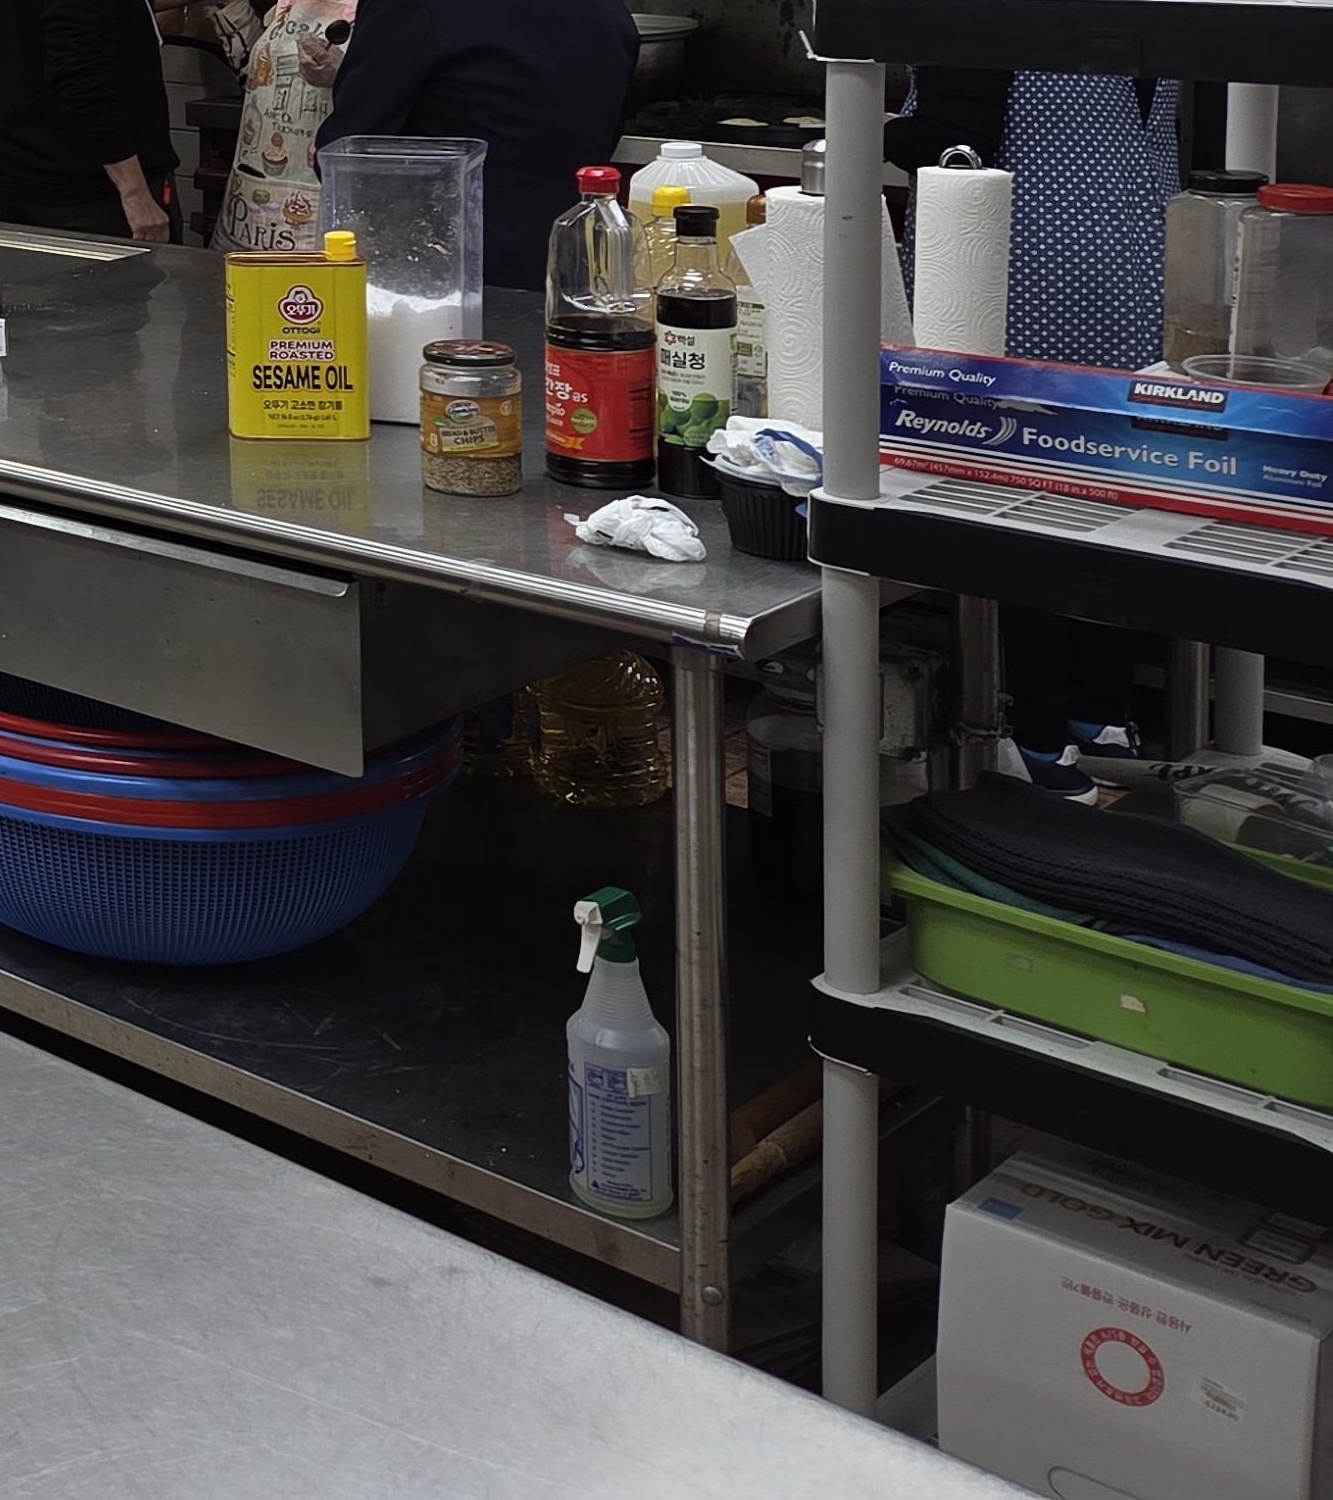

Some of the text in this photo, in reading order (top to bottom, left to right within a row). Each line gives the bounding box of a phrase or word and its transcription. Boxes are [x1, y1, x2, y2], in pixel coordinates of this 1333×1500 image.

[270, 351, 334, 360] ROASTED
[271, 341, 332, 350] PREMIUM
[252, 365, 353, 390] SESAME OIL
[889, 361, 996, 387] Premium Quality
[1134, 382, 1225, 404] KIRKLAND
[454, 434, 485, 445] CHIPS
[469, 425, 495, 435] BUTTER
[895, 409, 1237, 476] Reynolds Foodservice Foil
[1299, 470, 1328, 482] Duty
[1021, 1182, 1115, 1221] GOLD
[1119, 1217, 1192, 1250] MIX
[1194, 1241, 1319, 1294] GREEN
